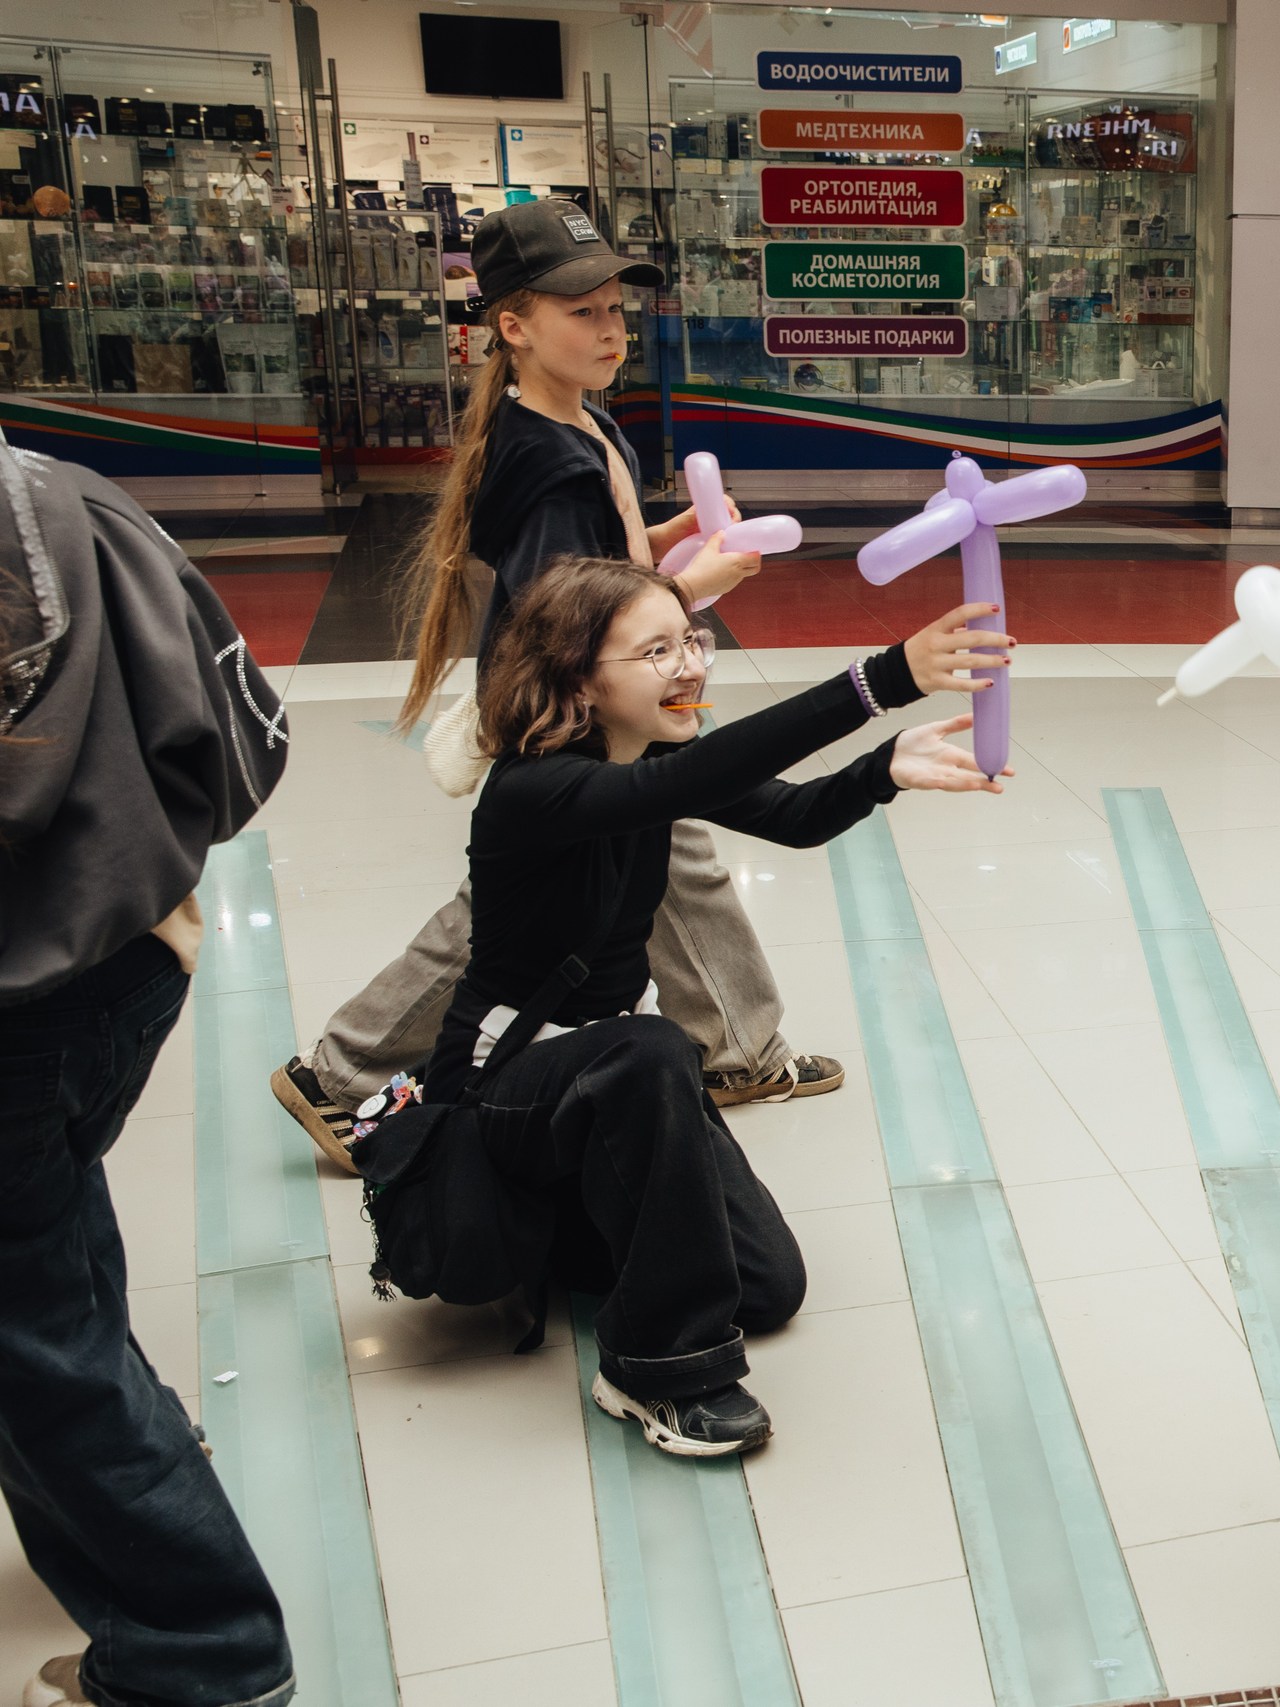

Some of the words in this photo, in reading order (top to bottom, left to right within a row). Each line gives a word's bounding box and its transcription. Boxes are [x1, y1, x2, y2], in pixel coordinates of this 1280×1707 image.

[770, 64, 949, 82] ВОДООЧИСТИТЕЛИ
[796, 122, 924, 141] МЕДТЕХНИКА
[804, 180, 922, 199] ОРТОПЕДИЯ,
[790, 199, 937, 218] РЕАБИЛИТАЦИЯ
[569, 219, 588, 227] NYC
[810, 254, 920, 272] ДОМАШНЯЯ
[792, 273, 940, 289] КОСМЕТОЛОГИЯ
[684, 318, 705, 329] 118
[779, 329, 870, 345] ПОЛЕЗНЫЕ
[874, 330, 954, 347] ПОДАРКИ
